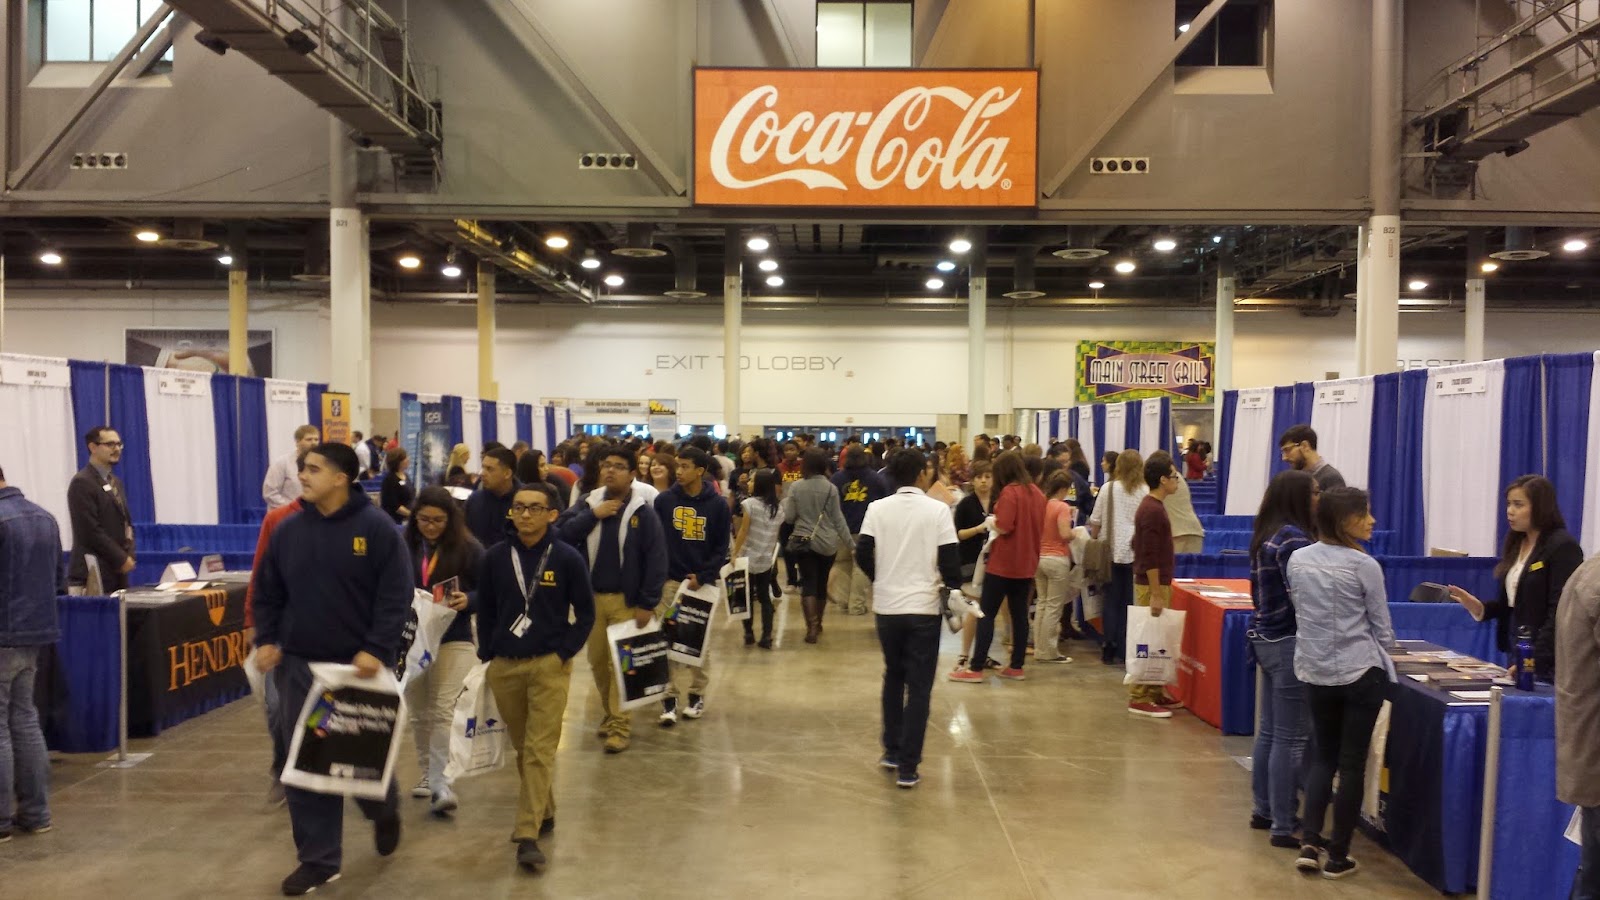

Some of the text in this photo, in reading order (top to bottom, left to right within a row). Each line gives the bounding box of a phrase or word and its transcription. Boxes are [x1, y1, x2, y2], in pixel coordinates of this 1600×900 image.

[710, 84, 1022, 191] Coca-Cola
[1383, 226, 1396, 234] B22
[656, 355, 710, 369] EXIT
[757, 356, 842, 371] LOBBY
[1090, 360, 1207, 385] MAIN STREET GRILL
